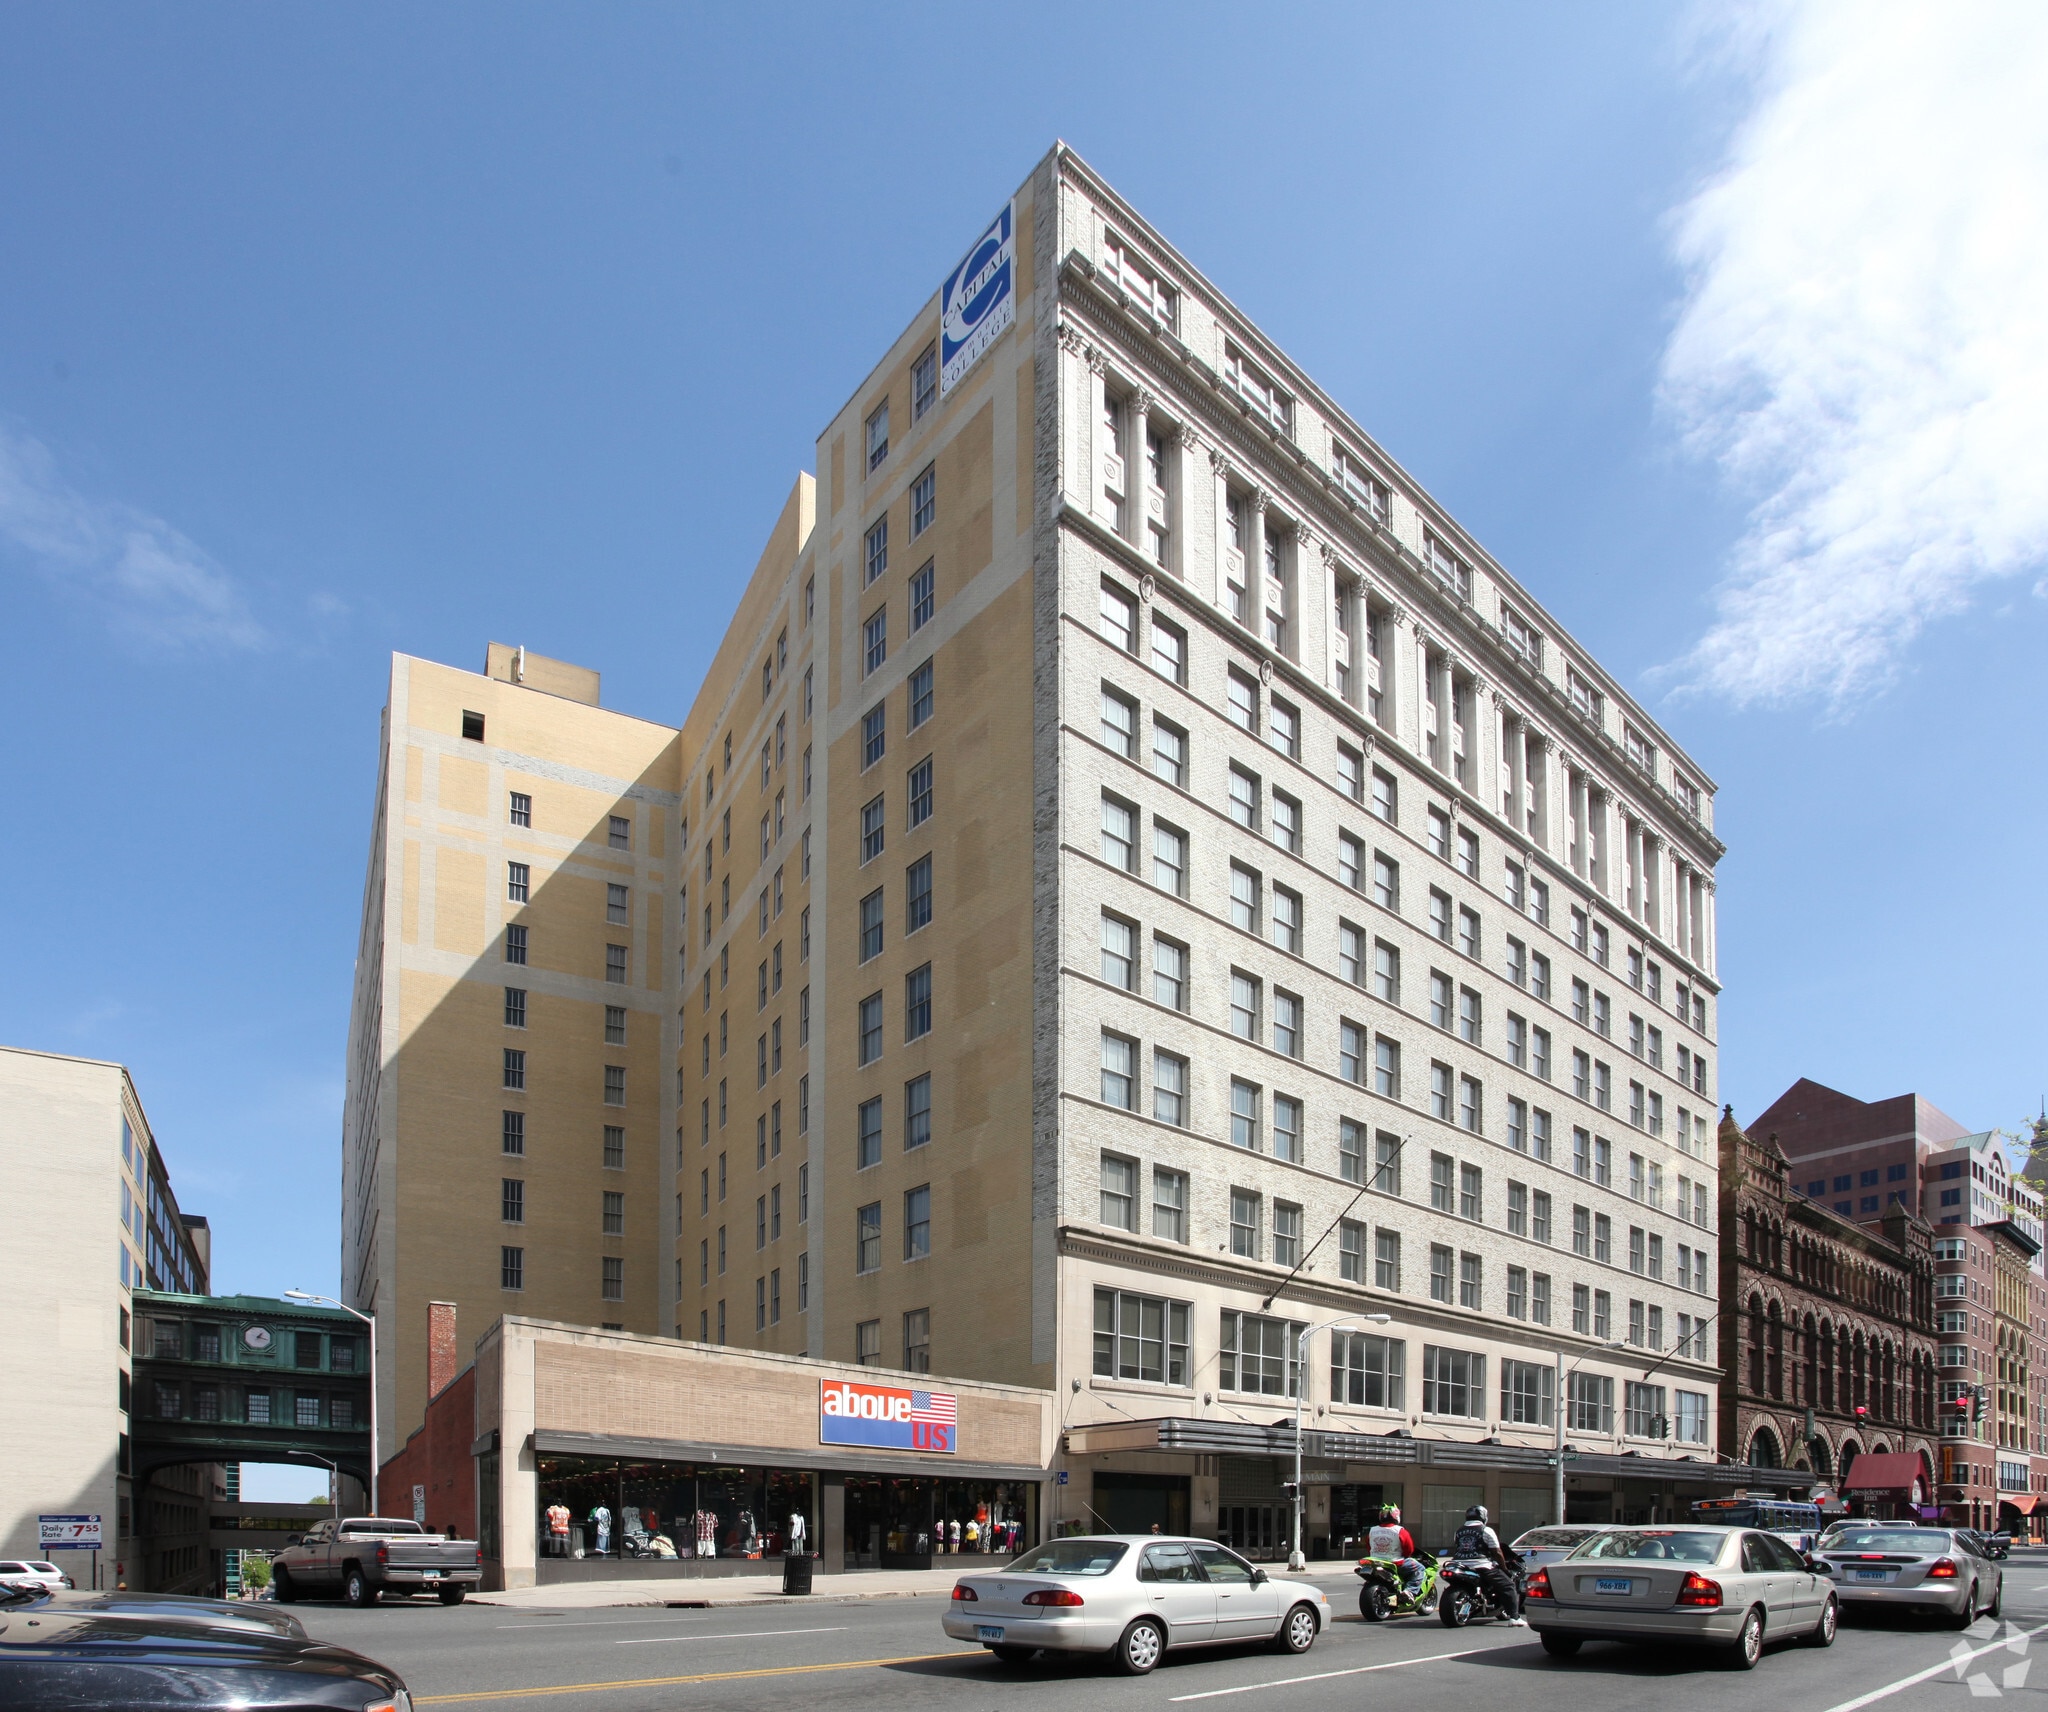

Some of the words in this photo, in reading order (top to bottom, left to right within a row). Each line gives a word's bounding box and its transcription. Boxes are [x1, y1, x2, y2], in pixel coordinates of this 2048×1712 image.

[943, 248, 1009, 330] CAPITAL
[941, 312, 1011, 393] COLLEGE
[824, 1384, 912, 1423] above
[1305, 1472, 1331, 1481] MAIN
